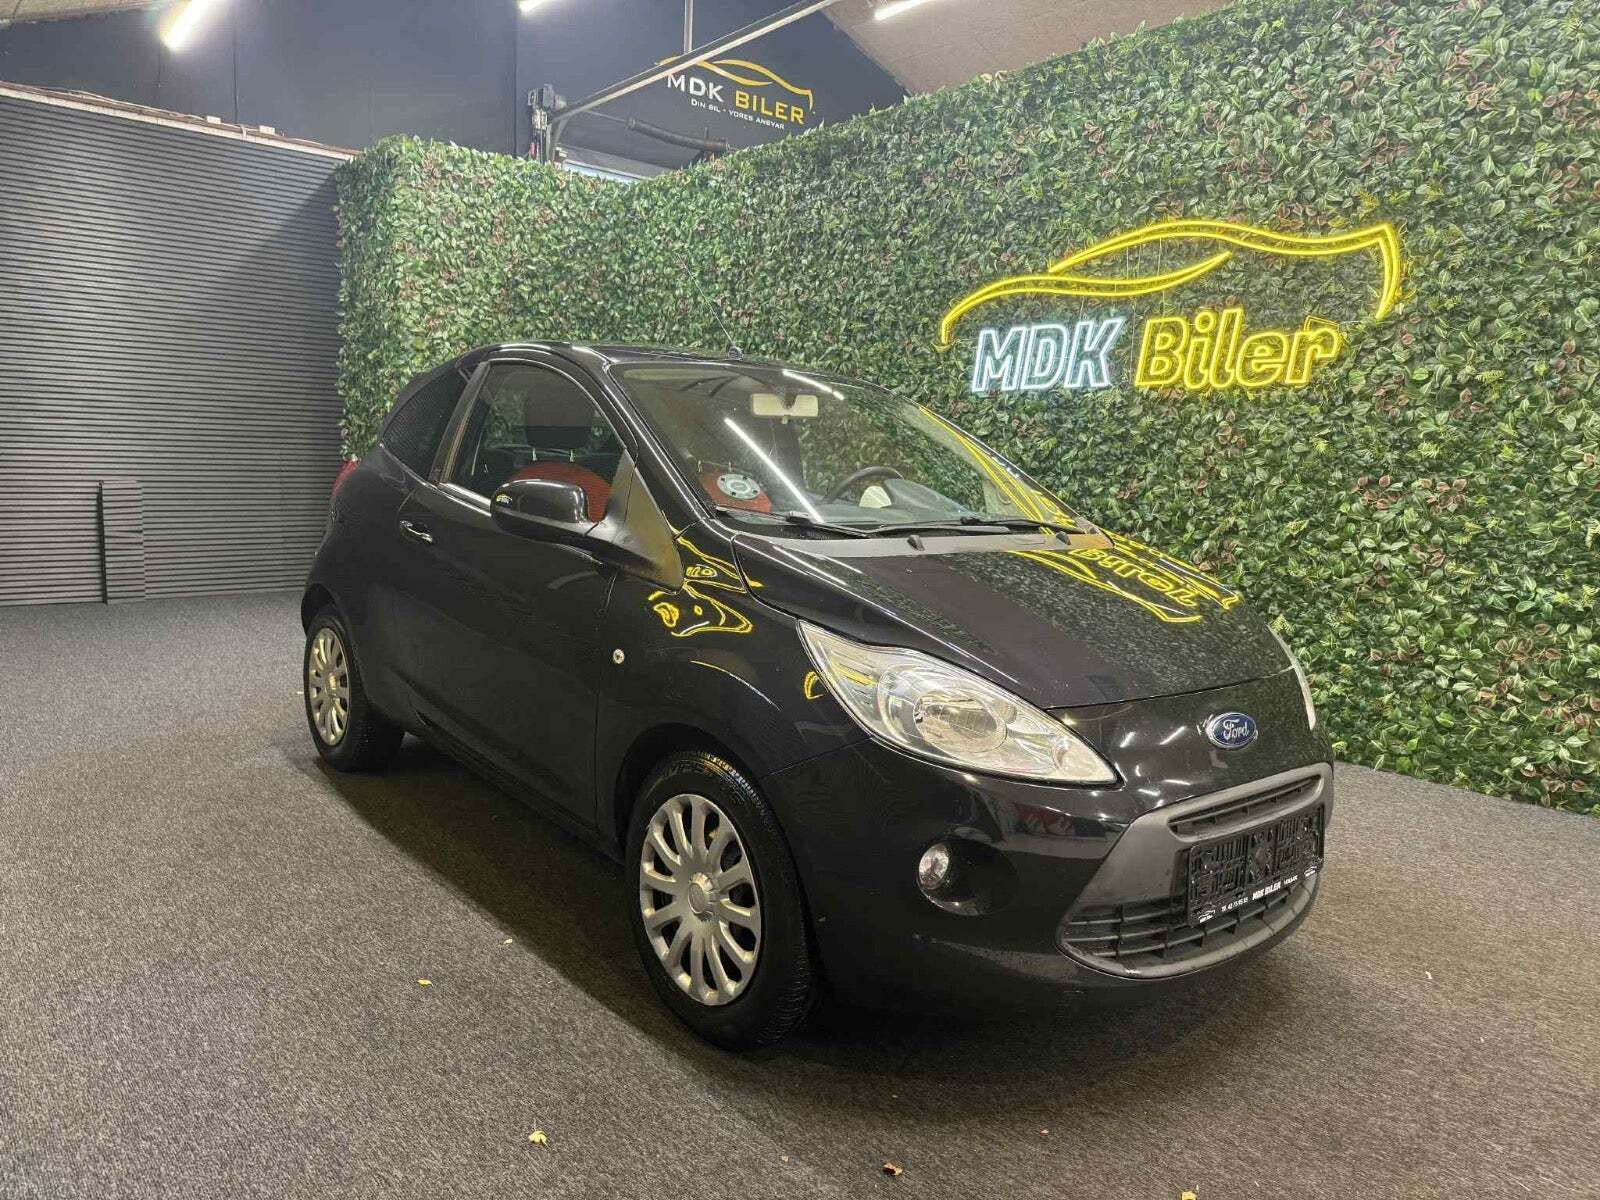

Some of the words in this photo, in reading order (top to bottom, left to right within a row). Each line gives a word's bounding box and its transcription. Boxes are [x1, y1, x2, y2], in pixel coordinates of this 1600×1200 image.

[667, 74, 725, 103] MDK
[735, 90, 805, 125] BILER
[971, 317, 1126, 392] MDK
[1134, 307, 1344, 389] Biler
[1223, 718, 1250, 741] Ford
